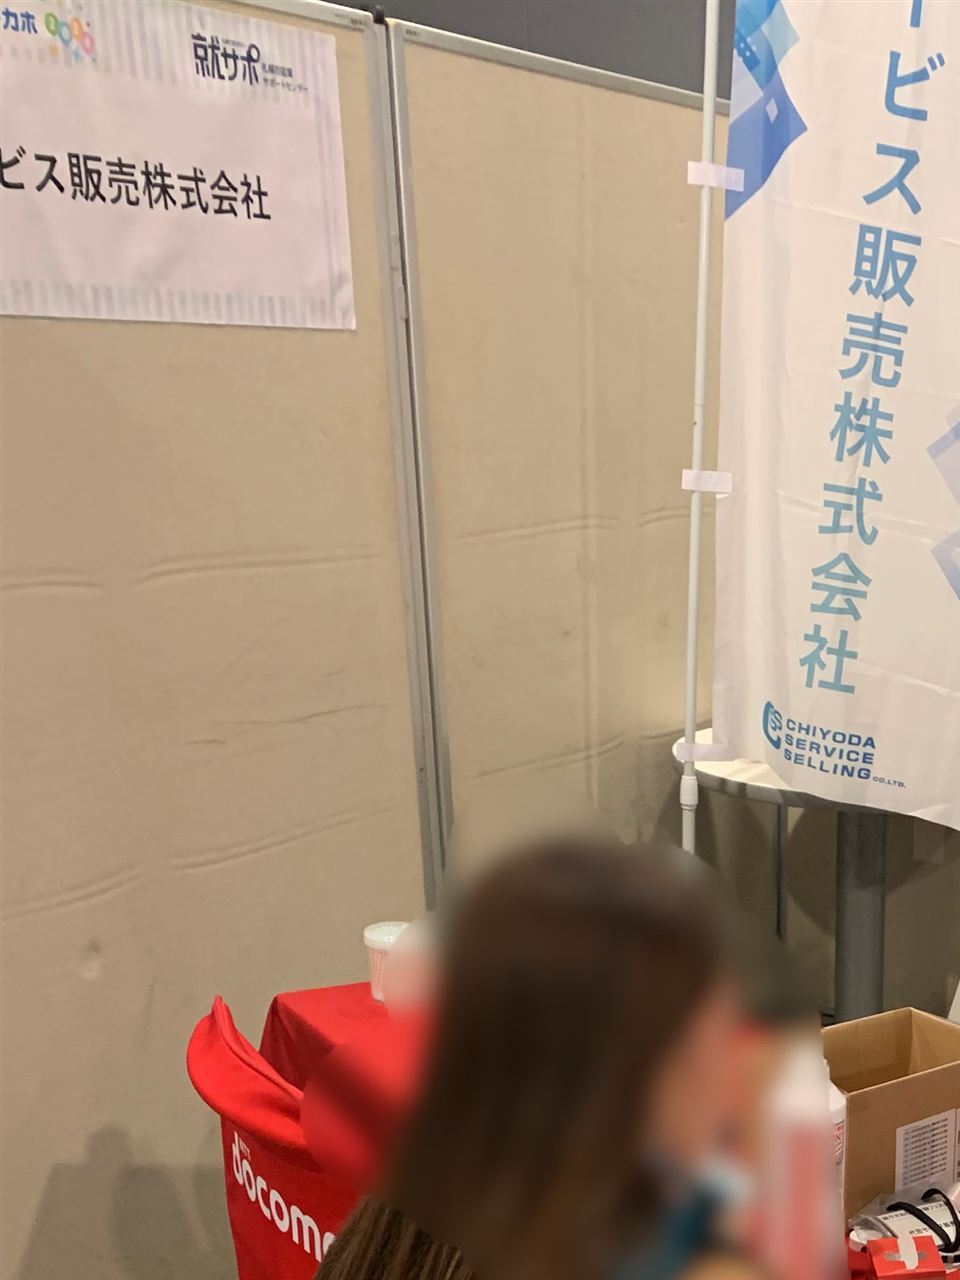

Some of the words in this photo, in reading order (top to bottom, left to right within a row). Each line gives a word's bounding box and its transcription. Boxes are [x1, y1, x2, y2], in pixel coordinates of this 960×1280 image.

[191, 33, 261, 86] 就サポ
[0, 145, 272, 220] ビス販売株式会社
[784, 733, 875, 765] SERVICE
[786, 718, 876, 750] CHIYODA
[783, 748, 872, 780] SELLING
